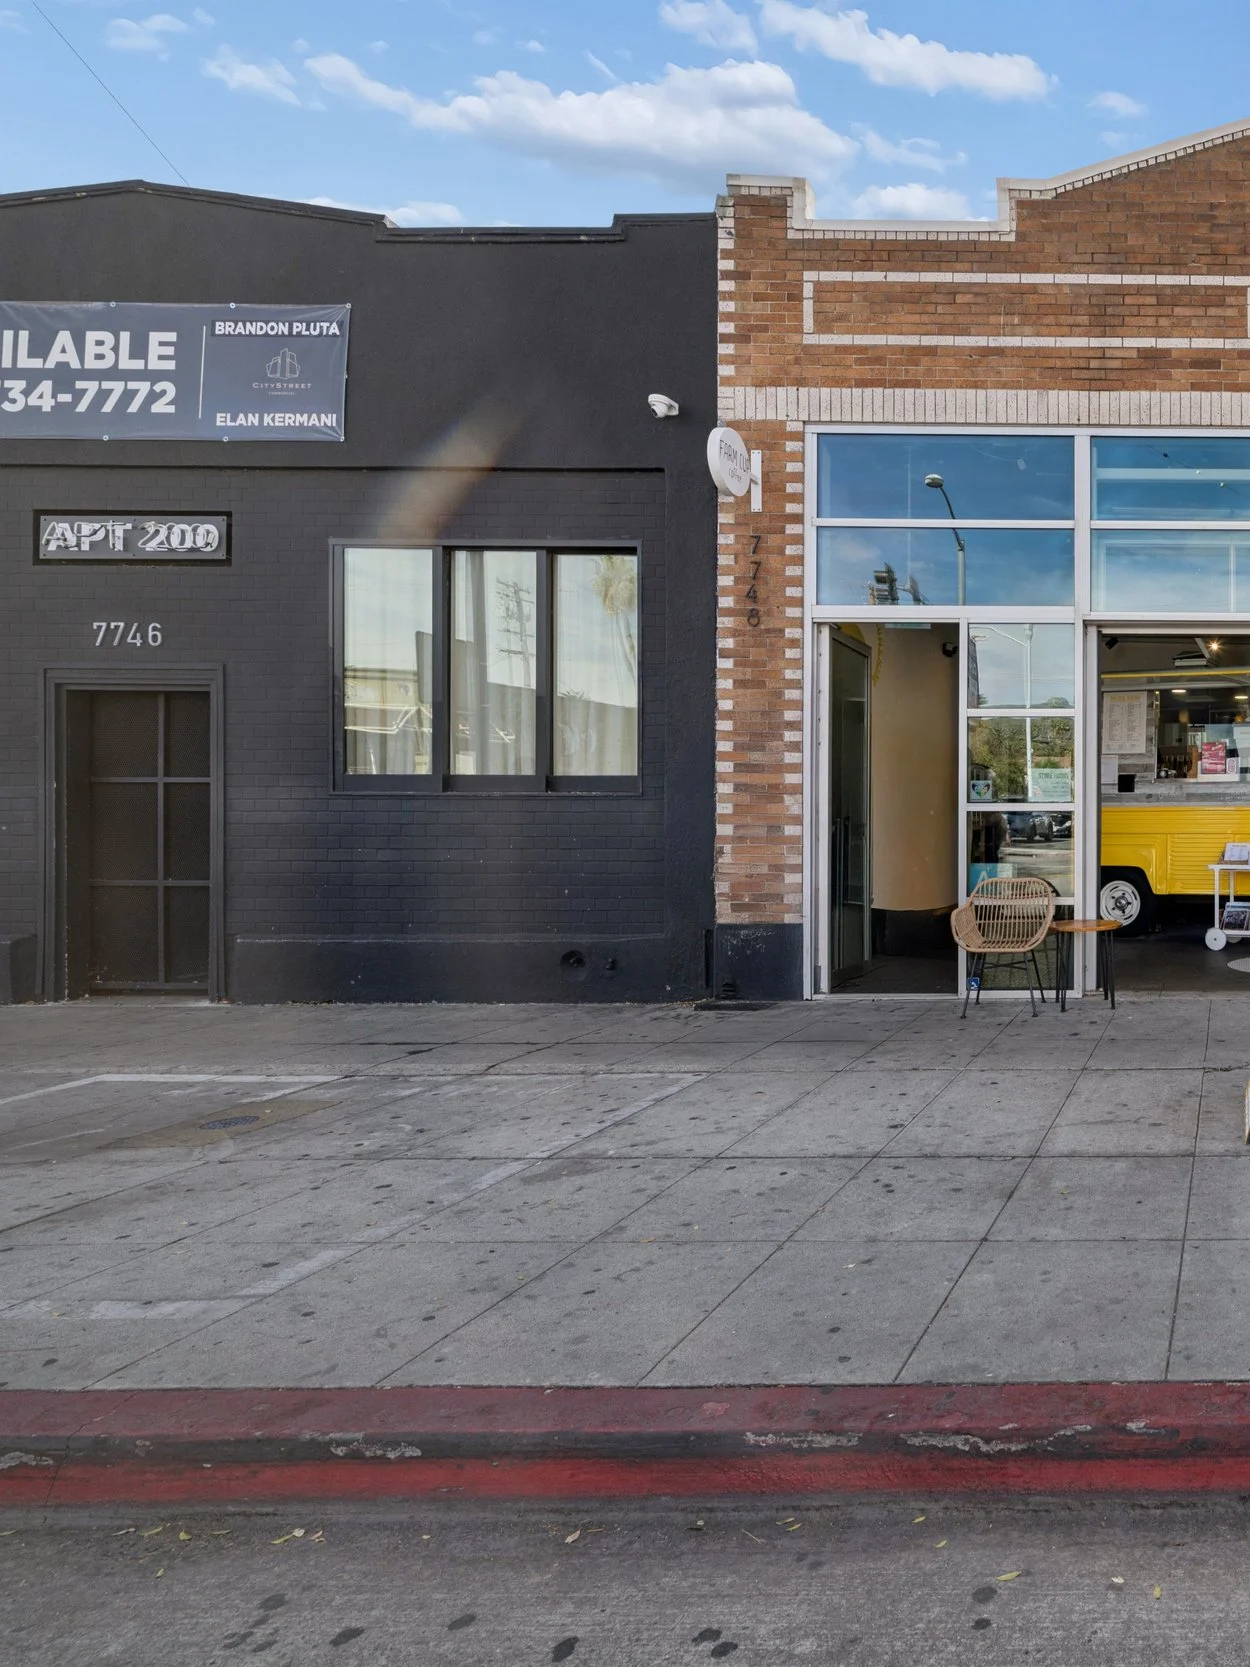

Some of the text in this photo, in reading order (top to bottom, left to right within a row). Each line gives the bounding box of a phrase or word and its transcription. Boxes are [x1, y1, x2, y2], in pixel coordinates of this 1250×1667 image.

[215, 321, 340, 336] BRANDON PLUTA
[1, 330, 177, 370] ILABLE
[1, 380, 177, 413] 34-7772
[216, 413, 337, 427] ELAN KERMANI
[719, 439, 751, 475] FARM CUP
[42, 520, 219, 551] APT 200
[745, 535, 761, 627] 7748
[92, 621, 163, 647] 7746
